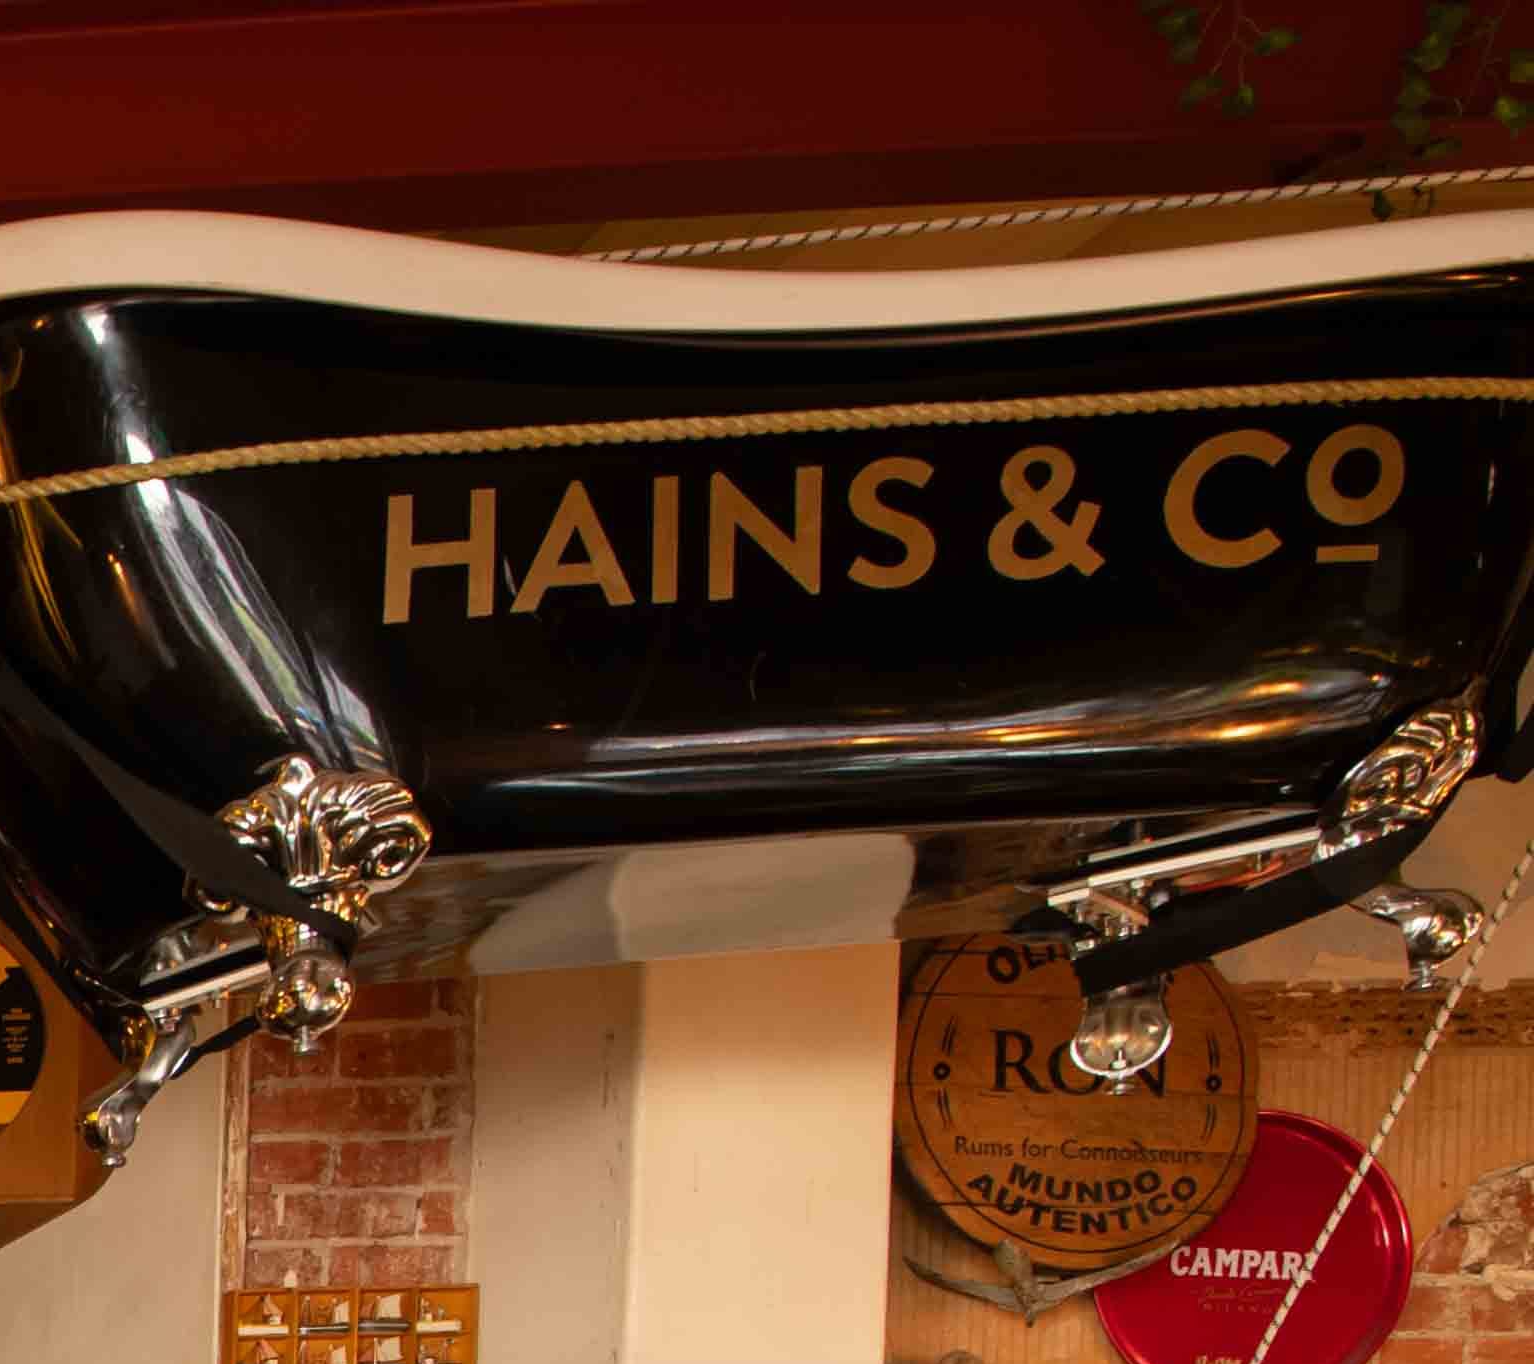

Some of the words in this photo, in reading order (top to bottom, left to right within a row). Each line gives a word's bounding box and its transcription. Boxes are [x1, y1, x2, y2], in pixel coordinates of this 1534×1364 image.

[382, 456, 936, 625] HAINS
[986, 444, 1106, 582] &
[953, 1135, 1014, 1157] Rums
[1021, 1137, 1054, 1159] for
[966, 1173, 1198, 1235] AUTENTICO
[1007, 1162, 1162, 1205] MUNDO
[1169, 1245, 1317, 1283] CAMPAR
